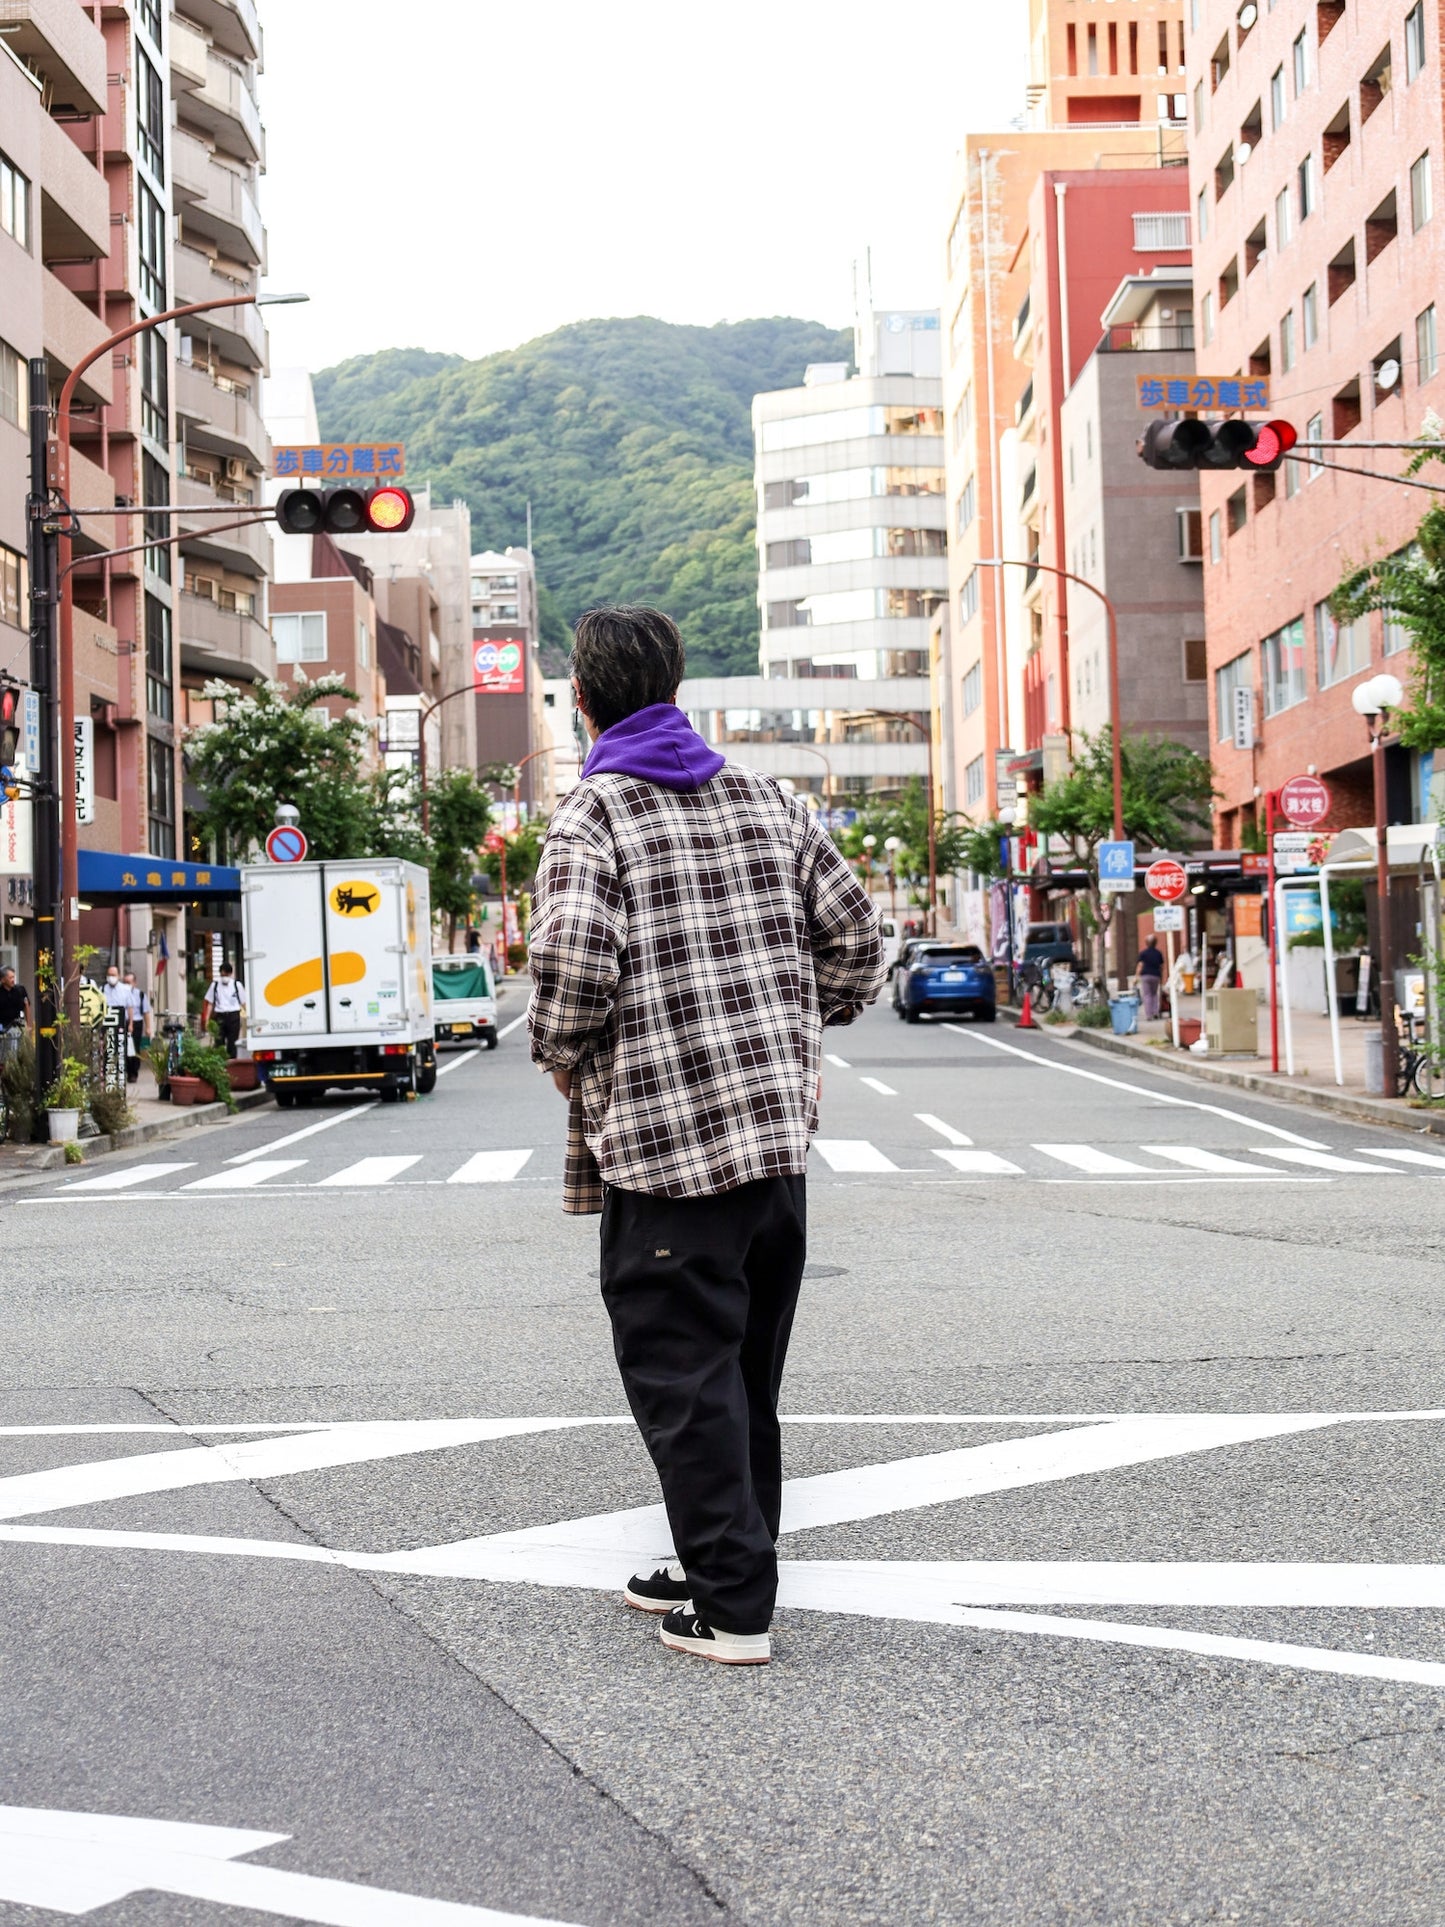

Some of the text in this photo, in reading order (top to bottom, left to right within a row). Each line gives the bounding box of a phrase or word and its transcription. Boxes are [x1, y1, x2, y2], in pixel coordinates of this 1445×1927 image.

[1140, 379, 1267, 408] 歩車分離式
[275, 448, 401, 475] 歩車分離式
[478, 652, 518, 666] COOP
[1287, 797, 1322, 813] 消火栓
[8, 832, 16, 863] School
[1104, 849, 1127, 873] 停
[270, 1021, 293, 1031] S9267
